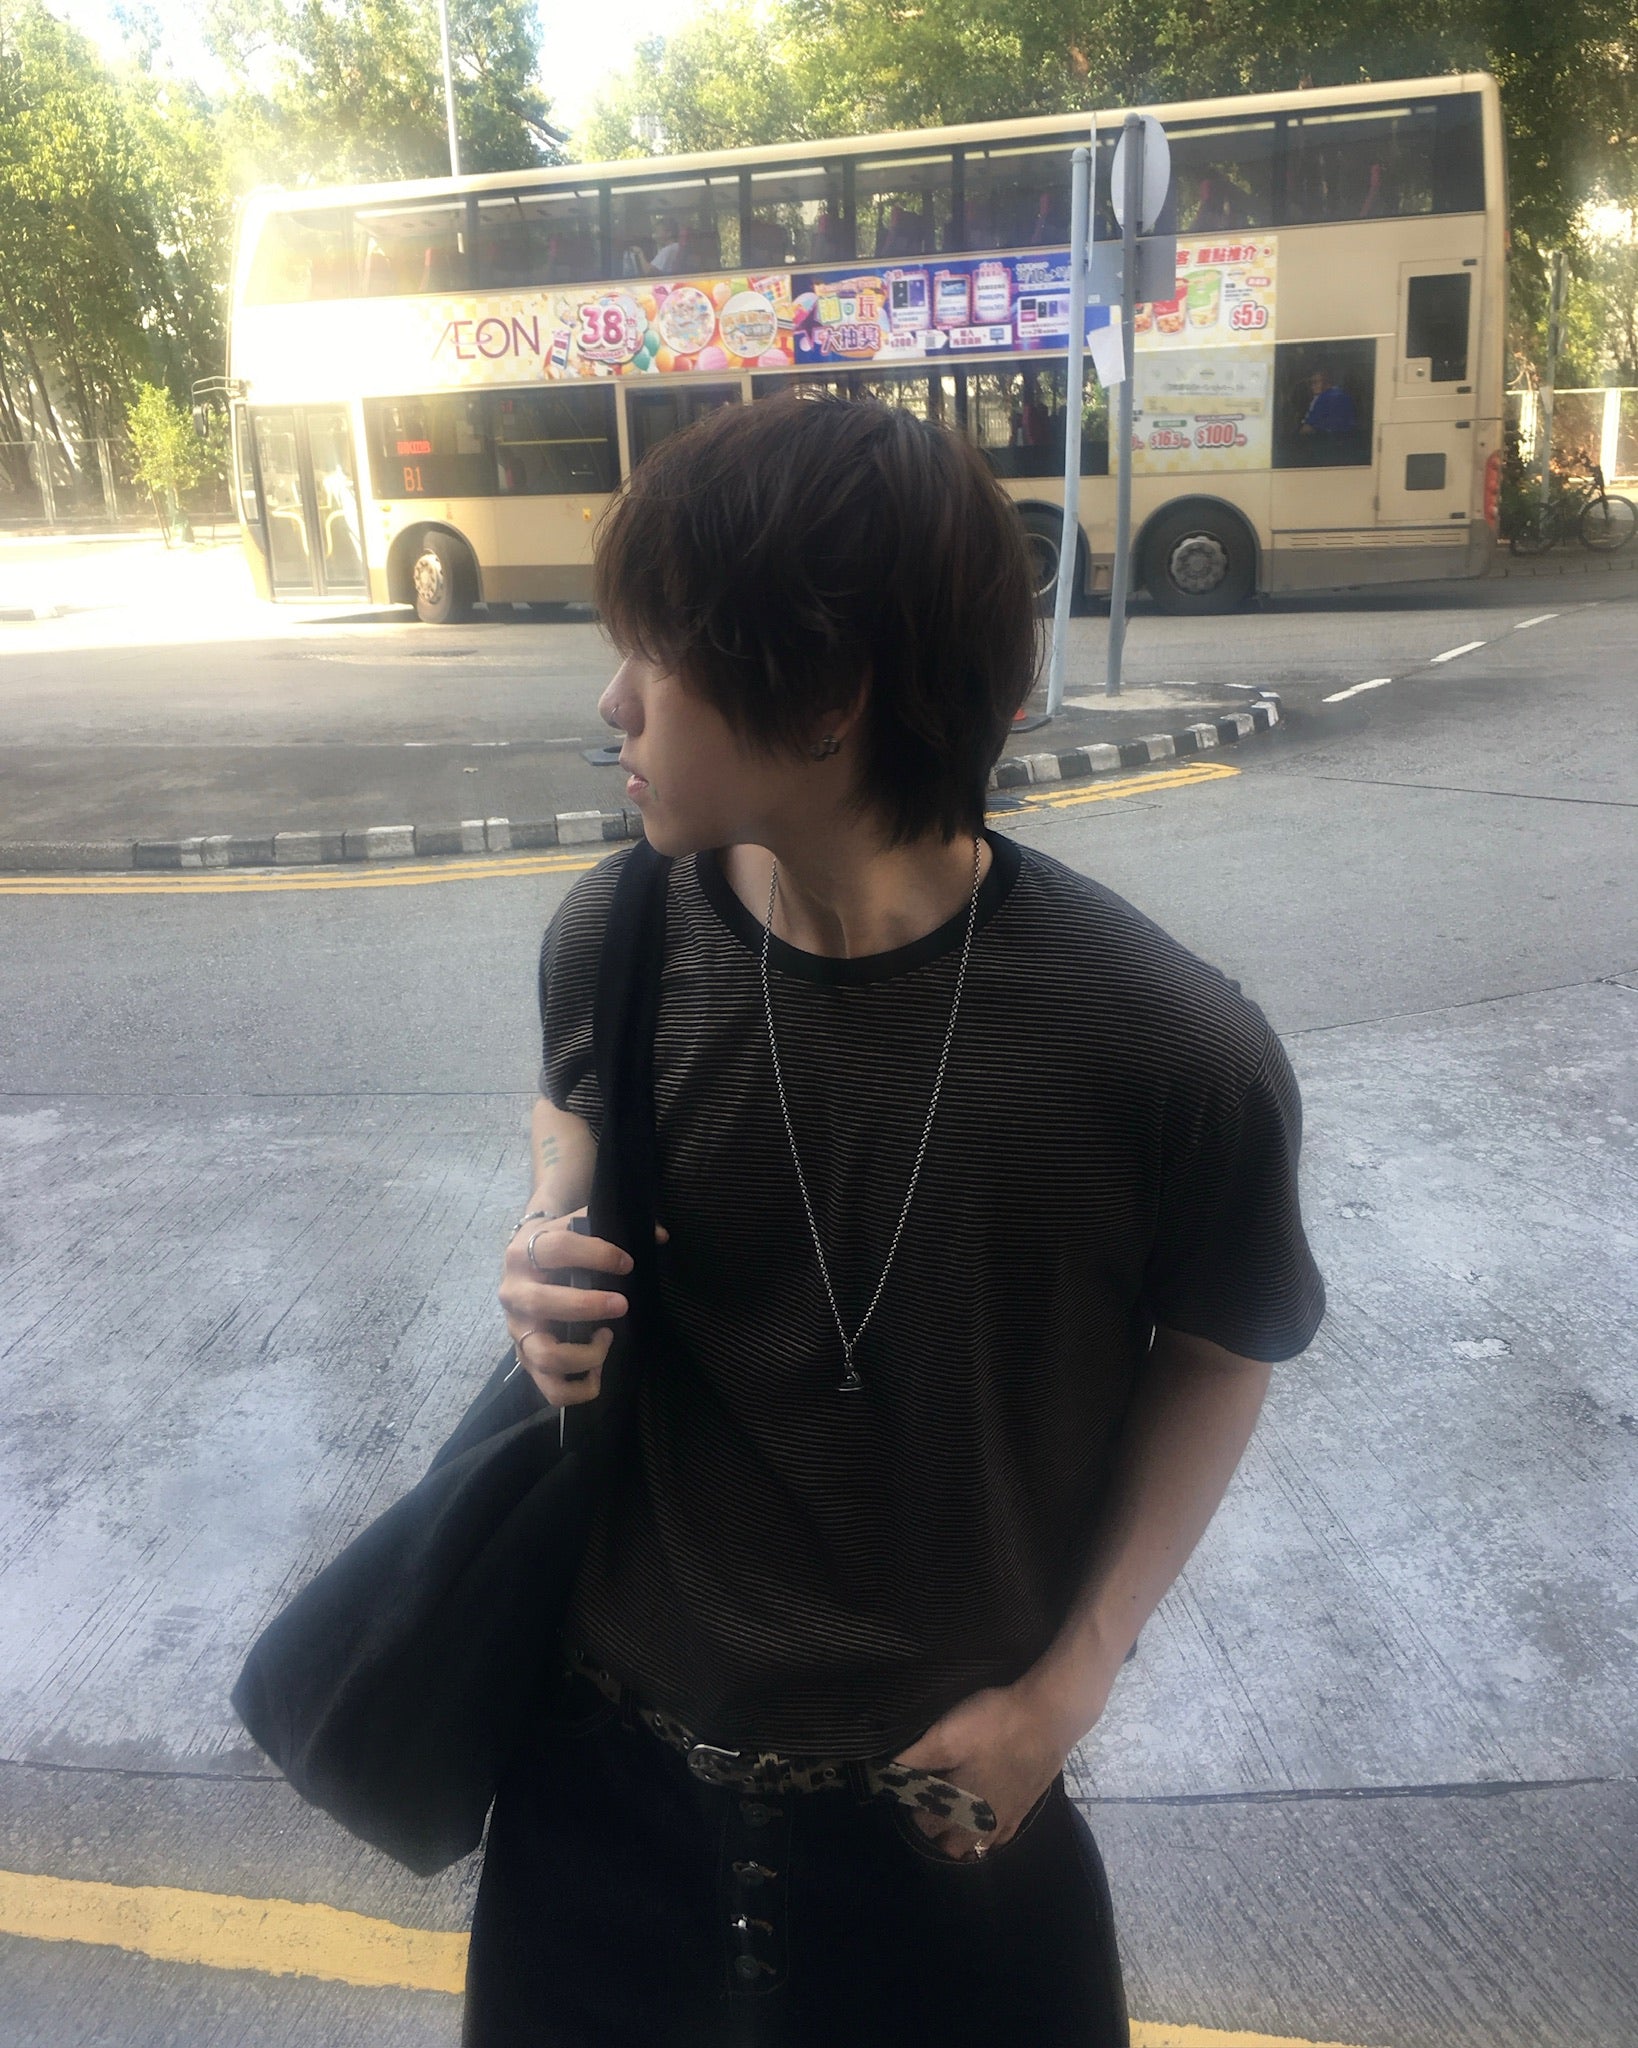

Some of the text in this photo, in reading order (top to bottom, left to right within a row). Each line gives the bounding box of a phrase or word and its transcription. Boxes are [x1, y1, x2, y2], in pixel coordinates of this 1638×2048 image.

[1232, 304, 1264, 327] $5.9
[1151, 431, 1181, 447] $16.5
[1197, 424, 1234, 445] $100
